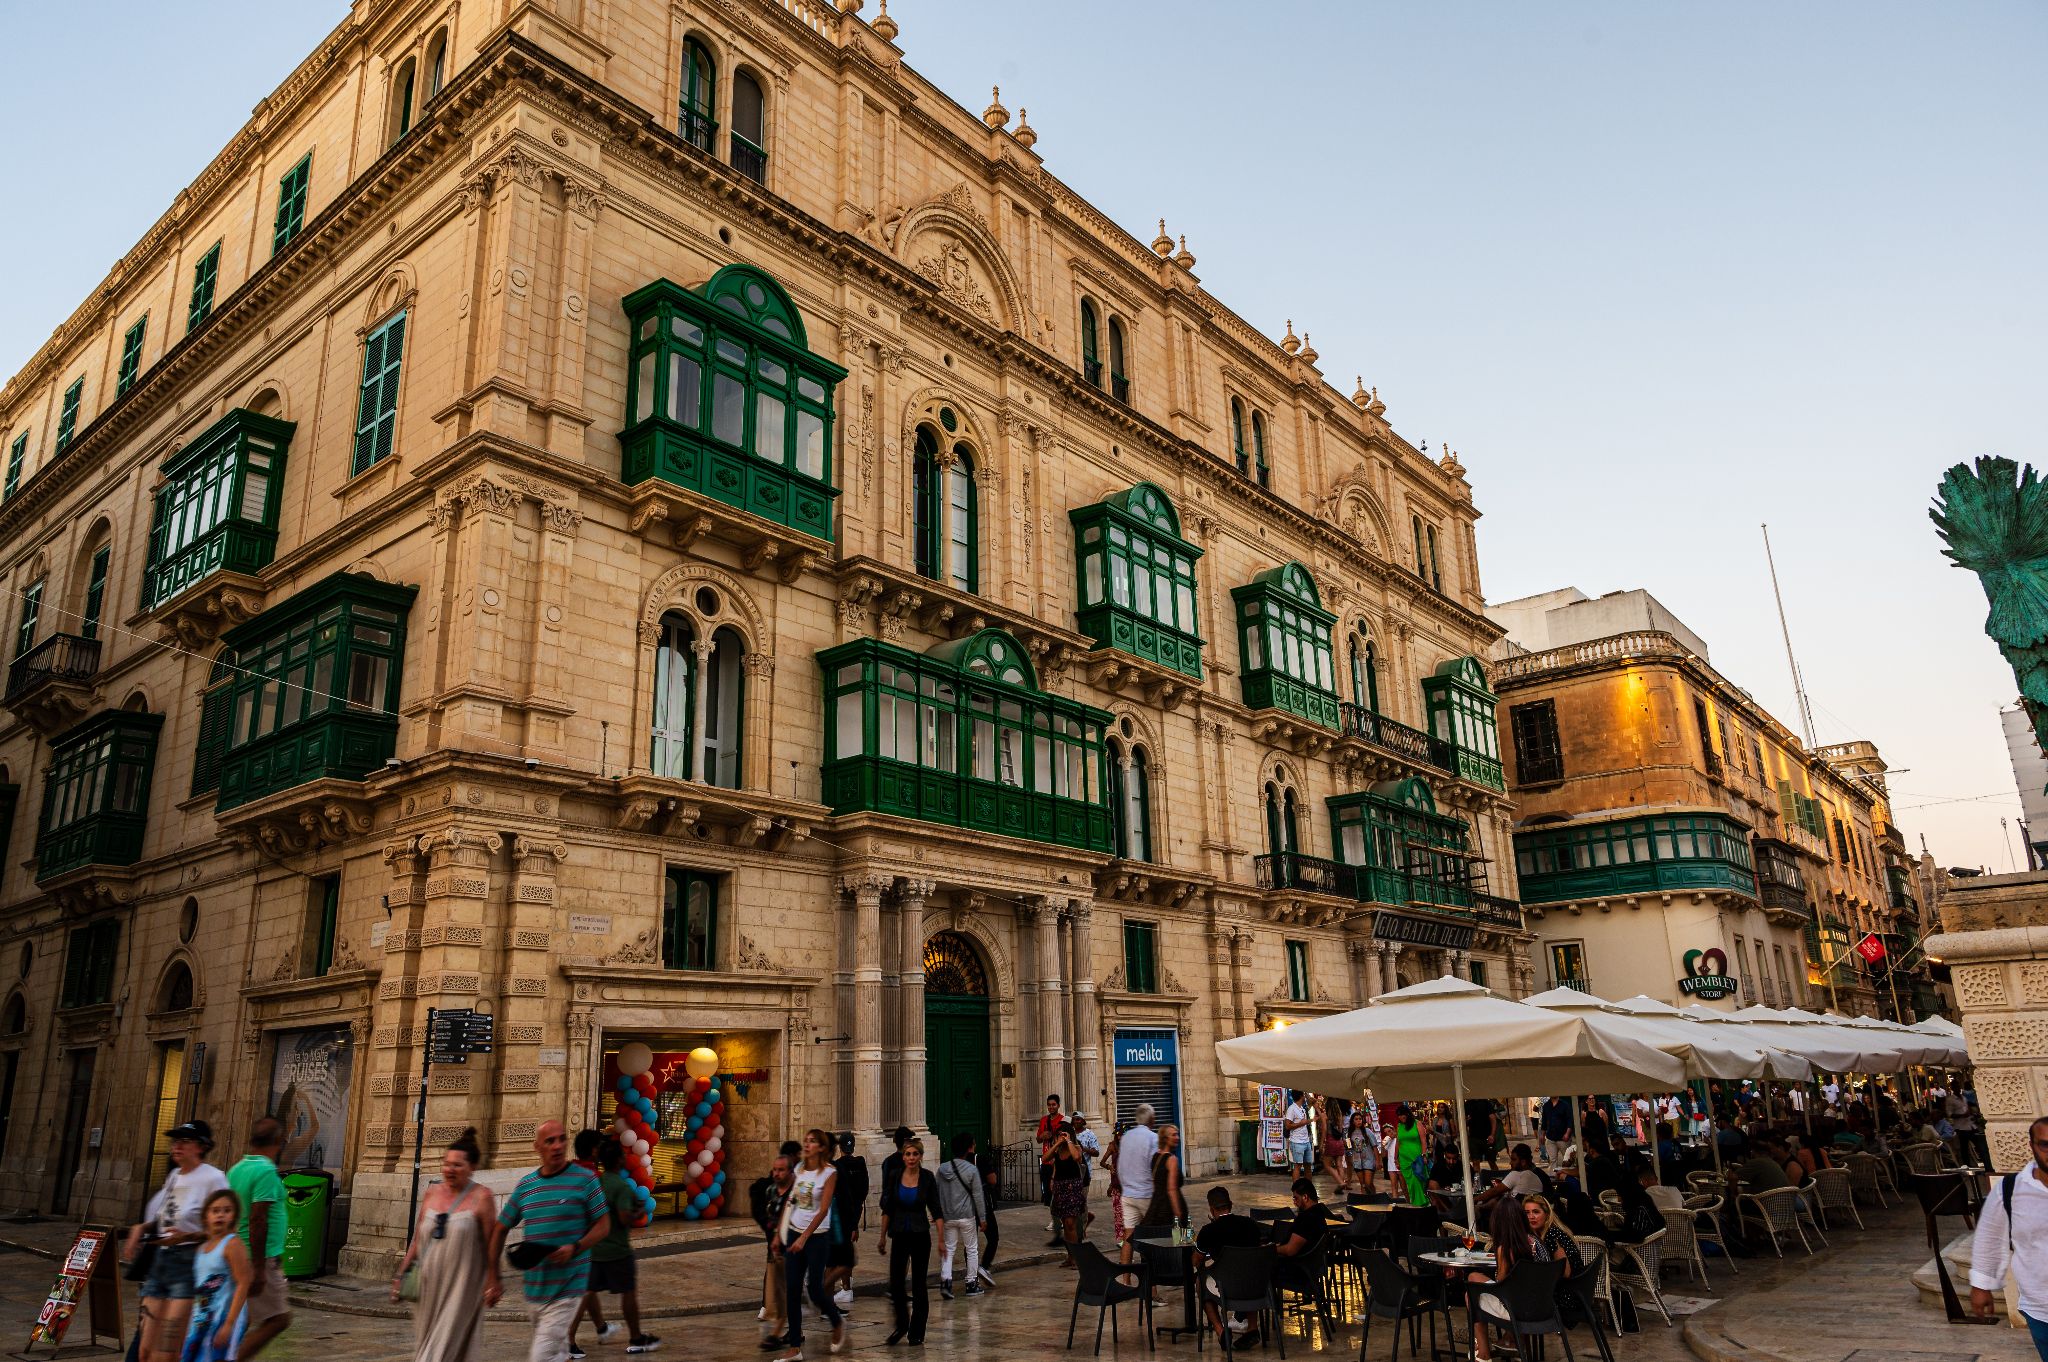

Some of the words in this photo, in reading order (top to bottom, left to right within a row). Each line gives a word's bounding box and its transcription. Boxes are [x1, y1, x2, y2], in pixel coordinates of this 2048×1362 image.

[1401, 920, 1438, 942] BATTA
[1440, 926, 1471, 947] DELIA
[1682, 976, 1735, 991] WEMBLEY
[1700, 990, 1723, 998] STORE
[310, 1048, 329, 1061] Malta
[1126, 1042, 1163, 1062] melita
[282, 1061, 328, 1082] CRUISES
